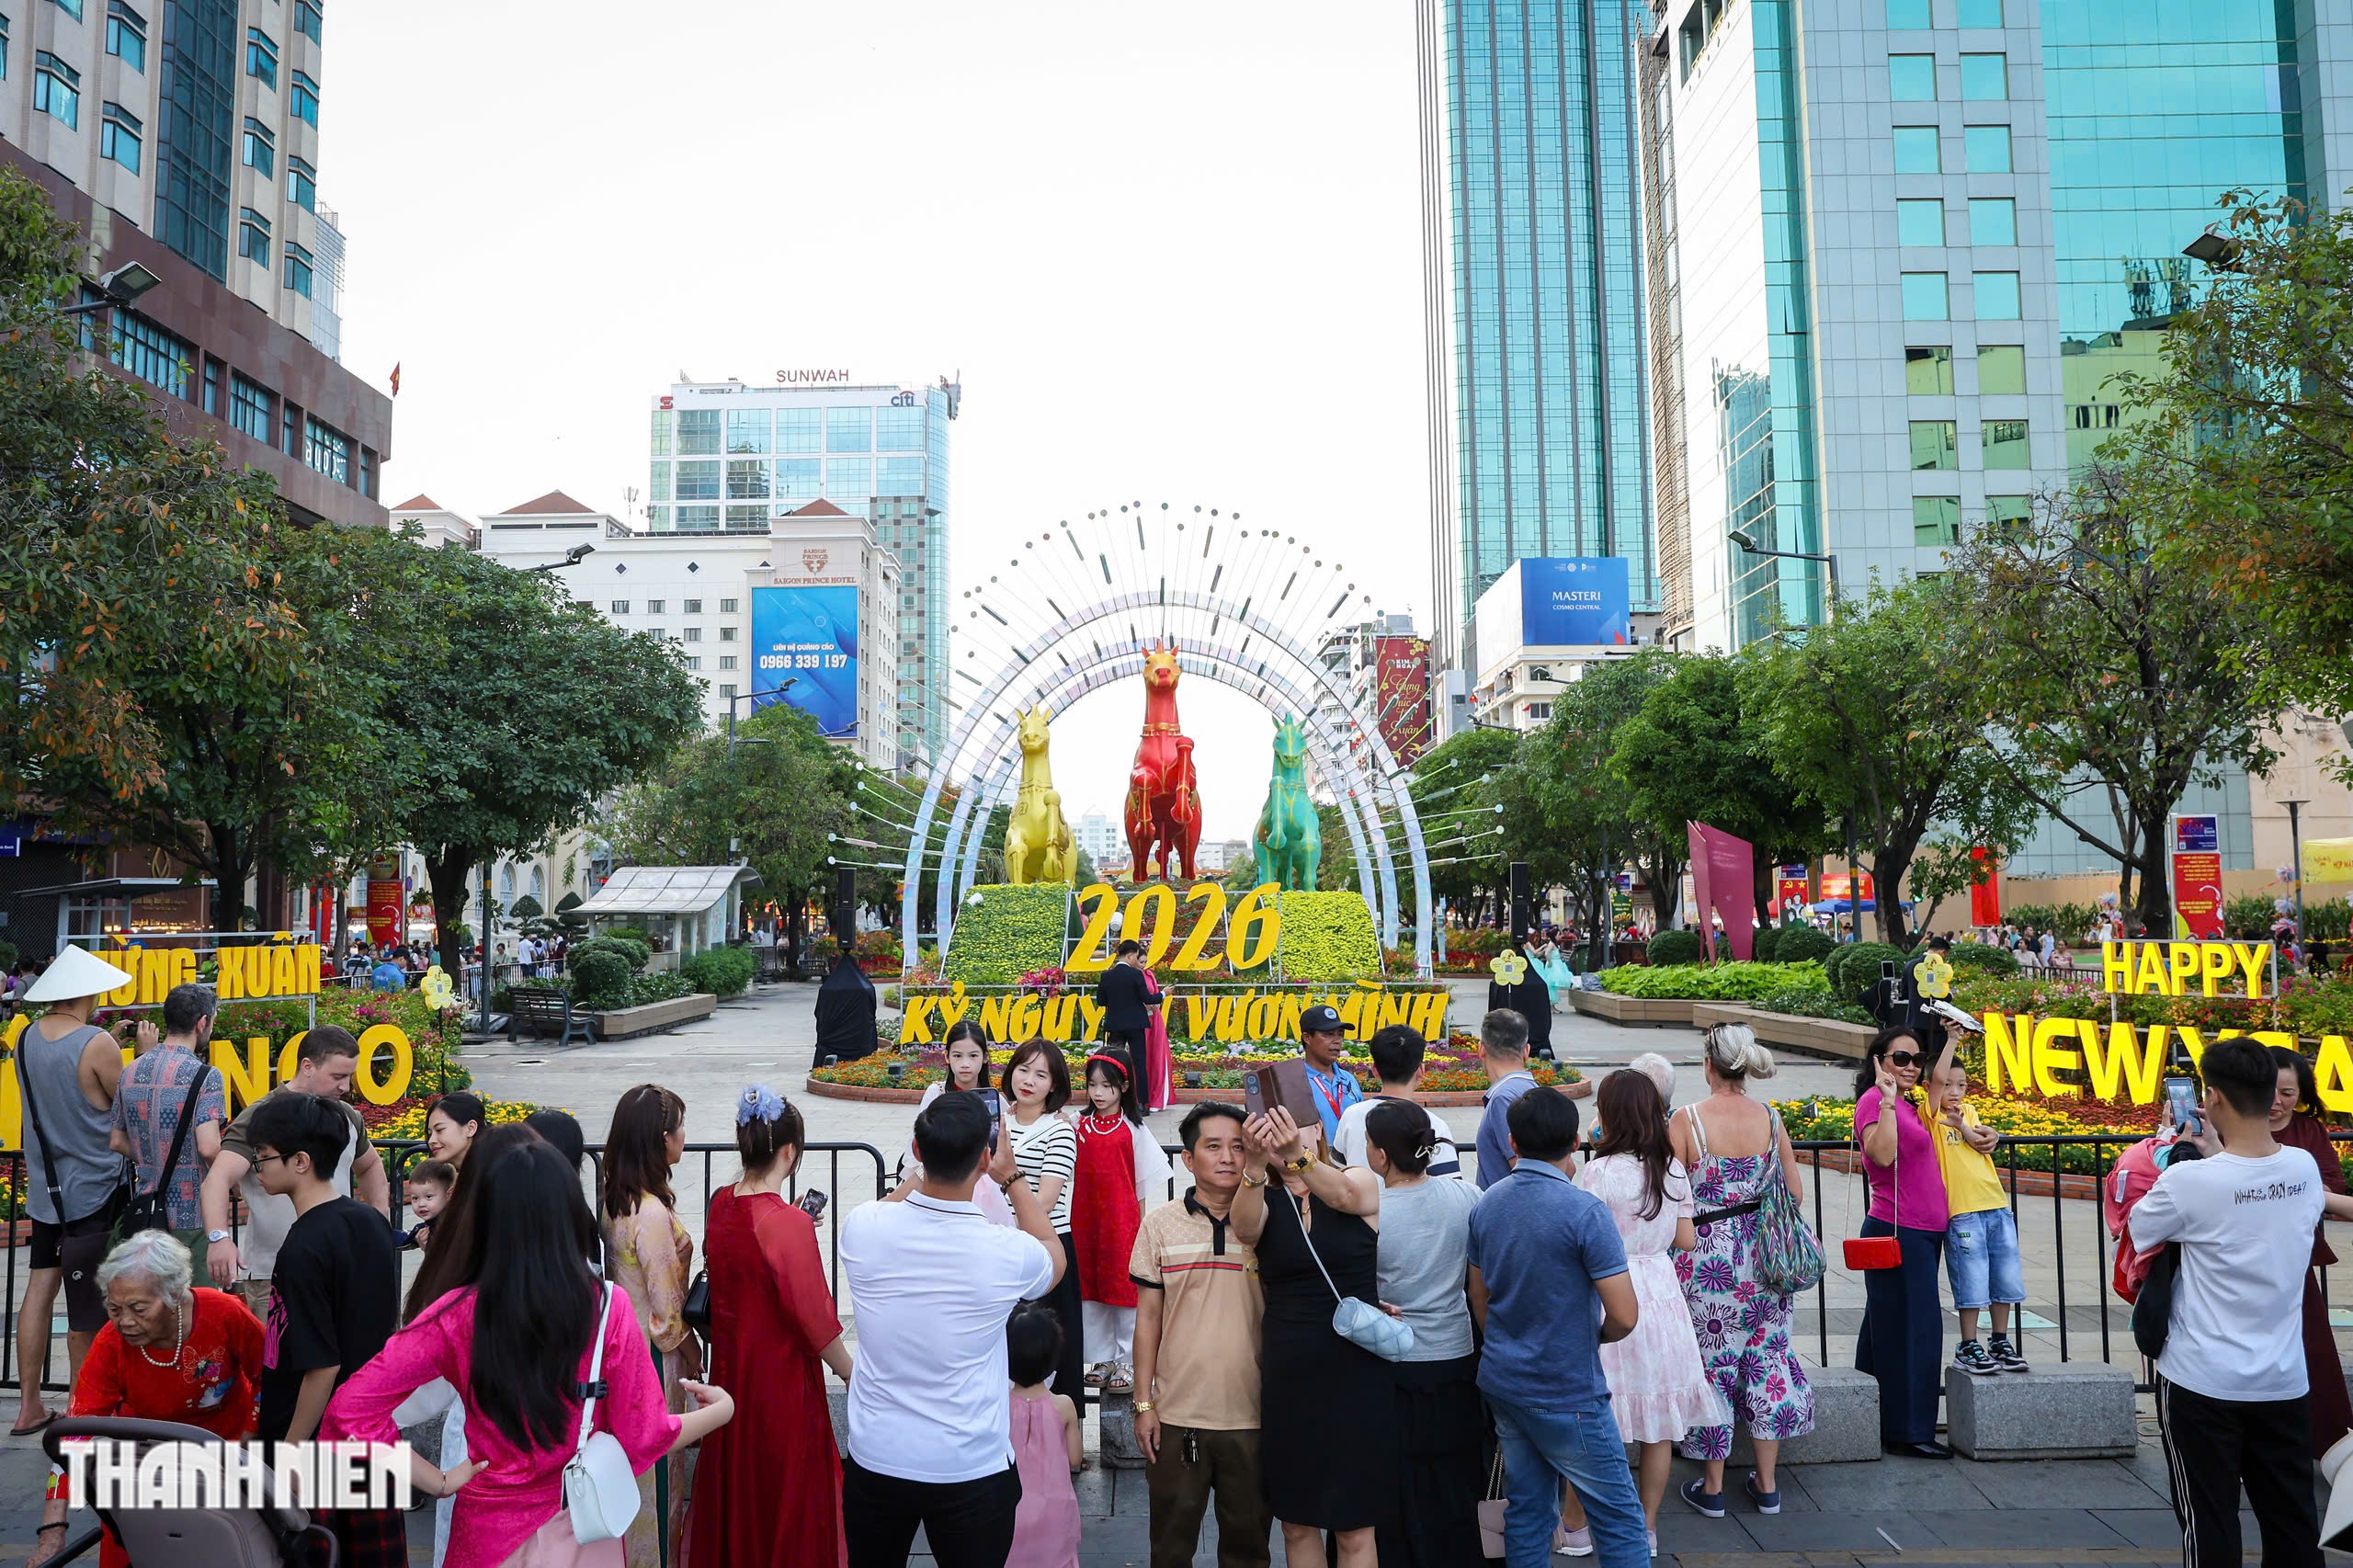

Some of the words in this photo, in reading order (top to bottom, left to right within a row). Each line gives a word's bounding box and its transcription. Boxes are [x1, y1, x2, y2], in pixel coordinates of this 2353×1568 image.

[777, 369, 849, 382] SUNWAH
[891, 391, 915, 406] citi
[1552, 591, 1601, 601] MASTERI
[760, 654, 791, 669] 0966
[795, 654, 820, 668] 339
[824, 654, 847, 668] 197
[1063, 882, 1281, 971] 2026
[89, 935, 197, 1006] ỪNG
[217, 931, 320, 999] XUÂN
[2103, 941, 2272, 1000] HAPPY
[900, 981, 969, 1045] KỶ
[1324, 980, 1449, 1042] MÌNH
[1984, 1012, 2172, 1106] NEW
[2234, 1188, 2255, 1205] WHAT
[2268, 1181, 2286, 1201] CRAZY
[2288, 1181, 2307, 1197] IDEA?
